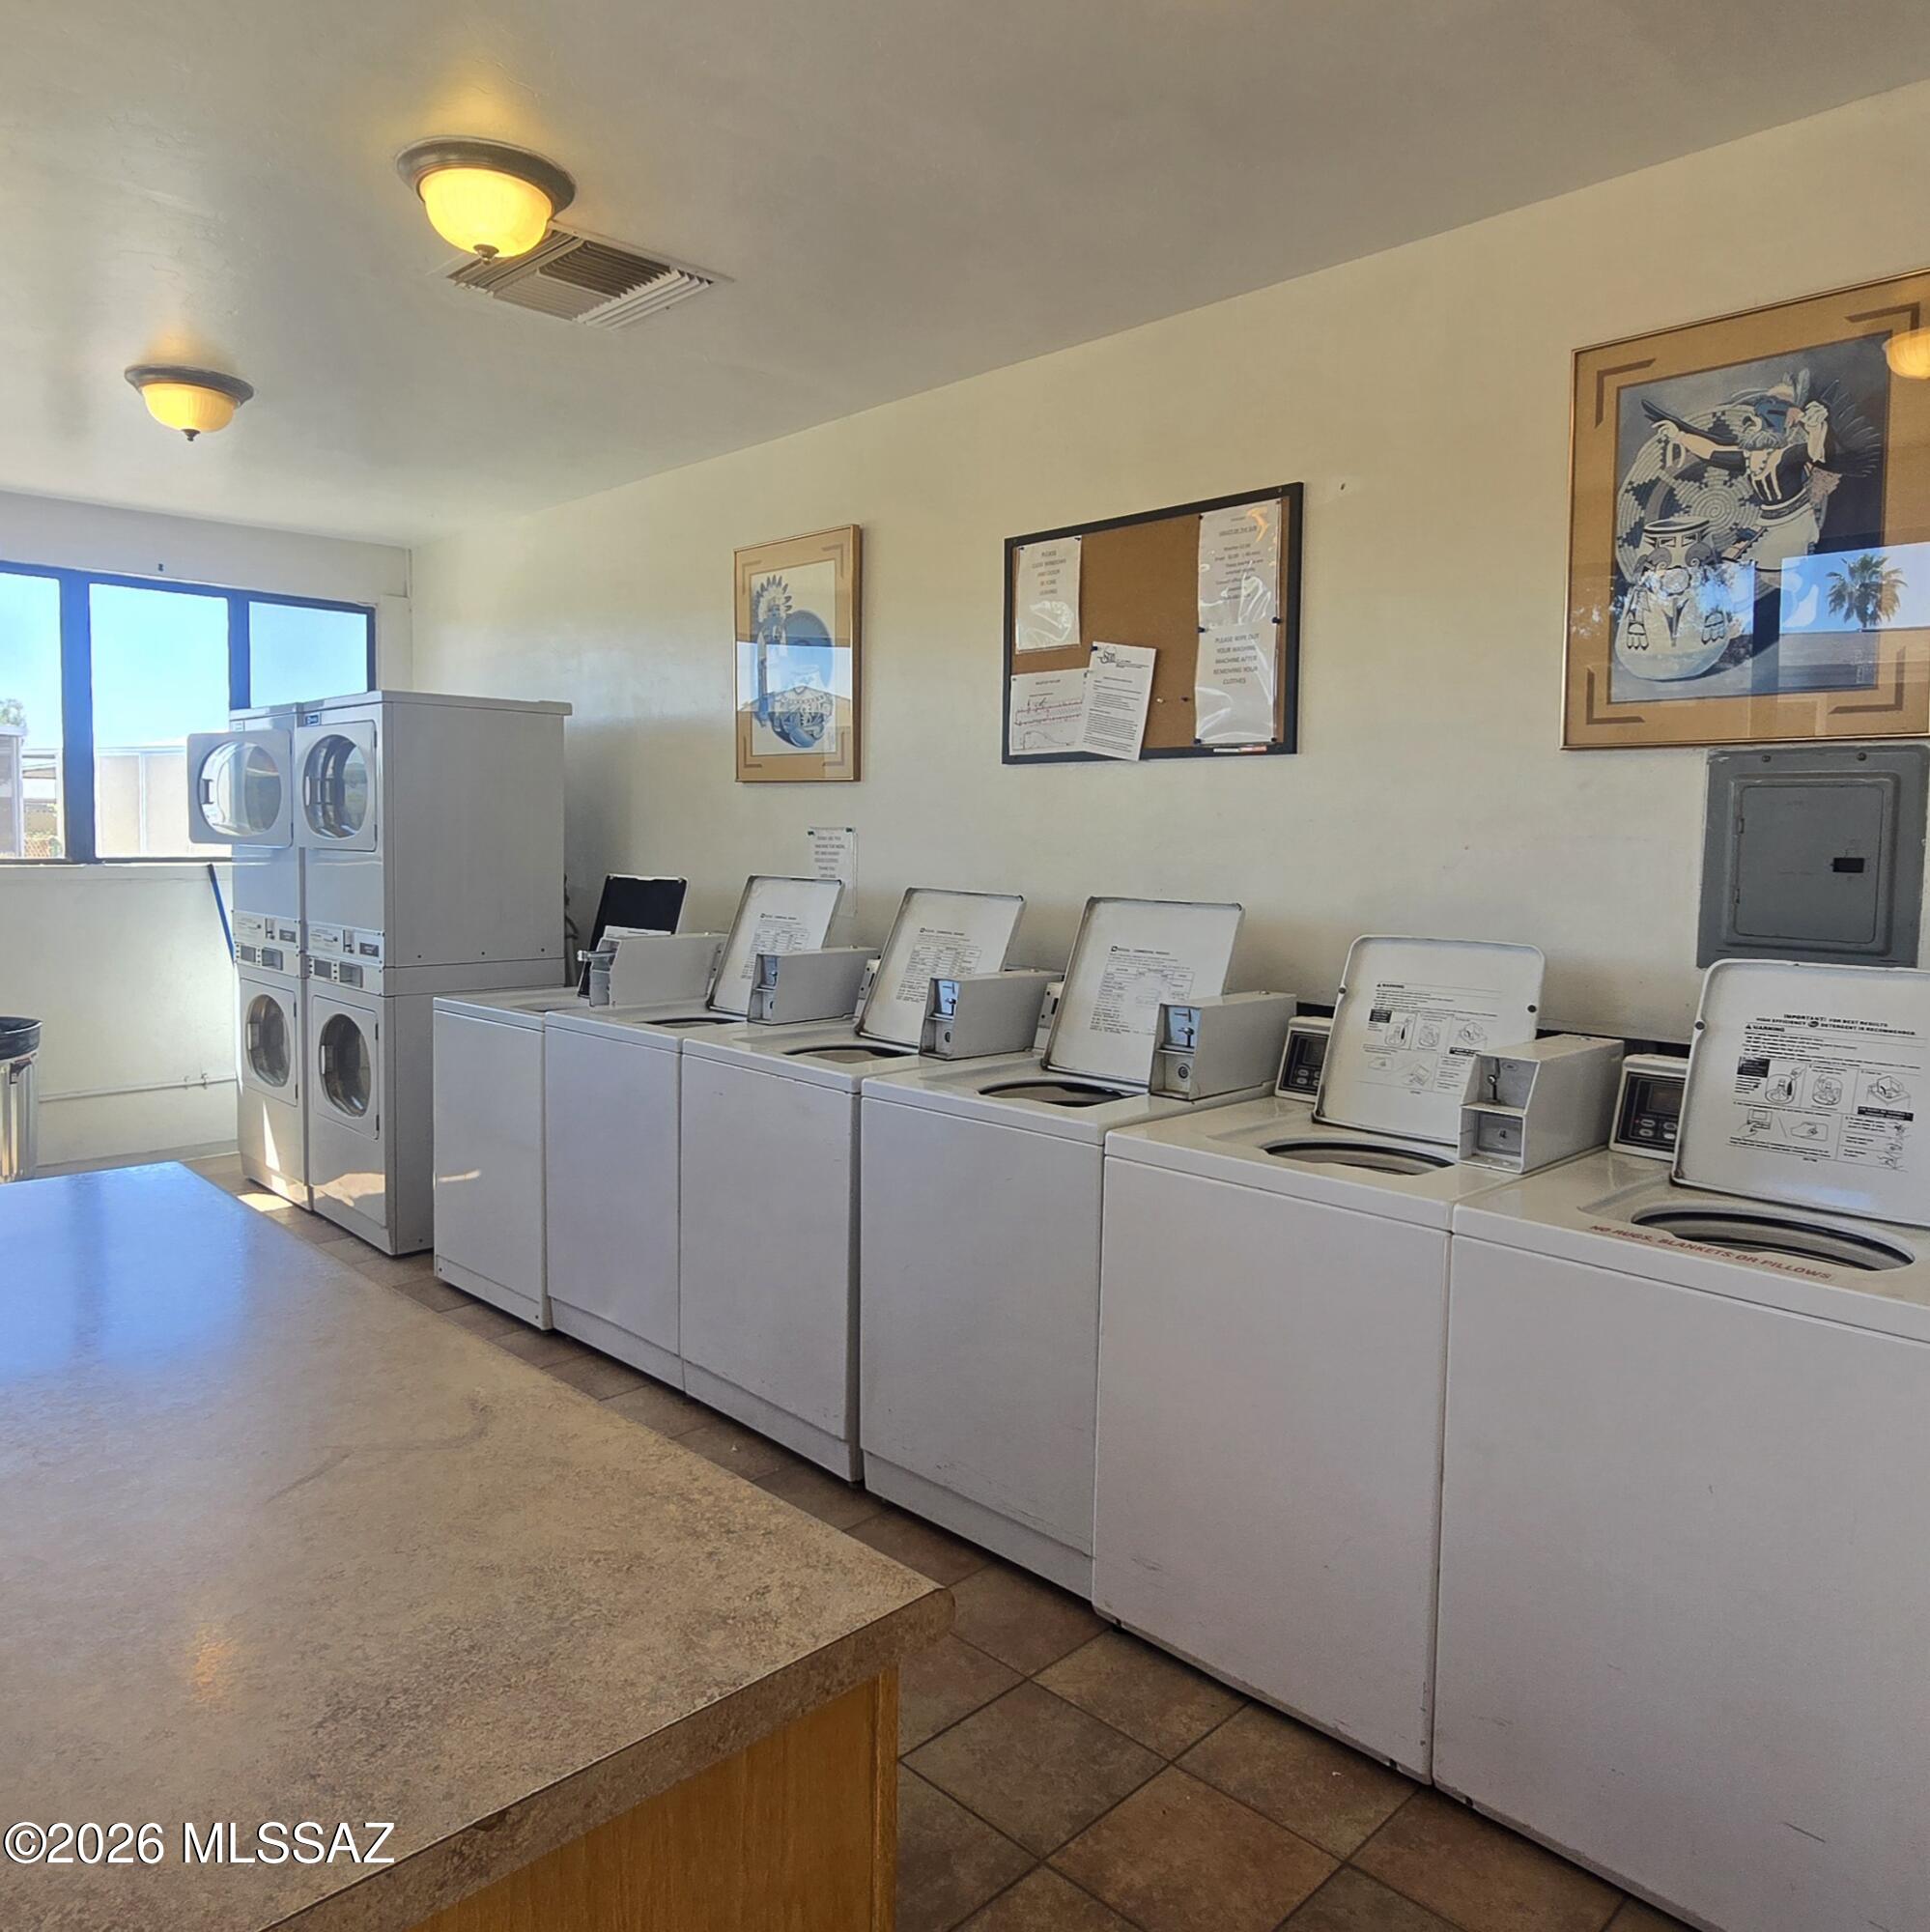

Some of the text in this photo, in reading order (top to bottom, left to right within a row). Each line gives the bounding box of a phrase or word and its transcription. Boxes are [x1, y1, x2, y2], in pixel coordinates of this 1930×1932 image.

[1658, 1238, 1733, 1258] BLANKETS
[1735, 1254, 1759, 1264] OR
[1760, 1259, 1832, 1280] PILLOWS
